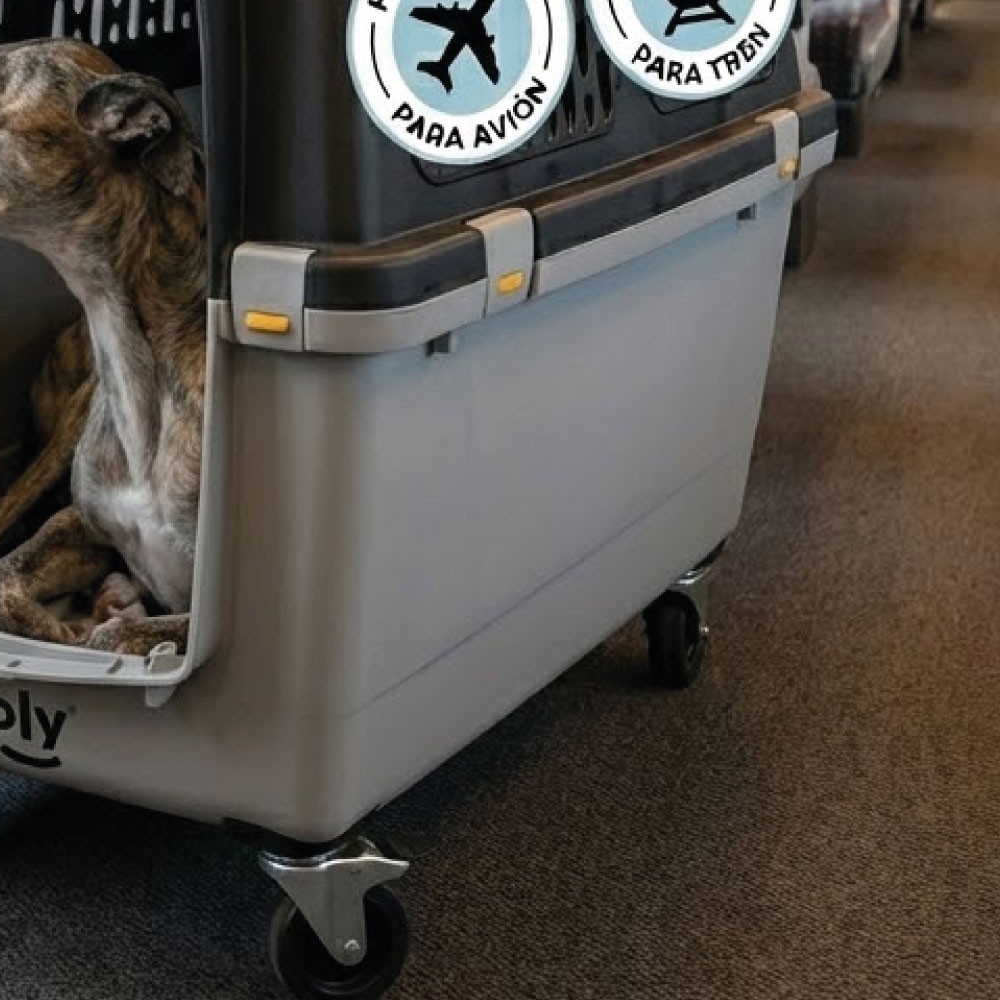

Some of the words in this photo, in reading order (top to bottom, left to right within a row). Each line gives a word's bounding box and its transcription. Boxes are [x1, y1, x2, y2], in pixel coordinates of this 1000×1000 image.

[632, 43, 703, 85] PARA
[707, 22, 770, 80] TREN
[391, 102, 464, 149] PARA
[473, 76, 547, 148] AVIÓN
